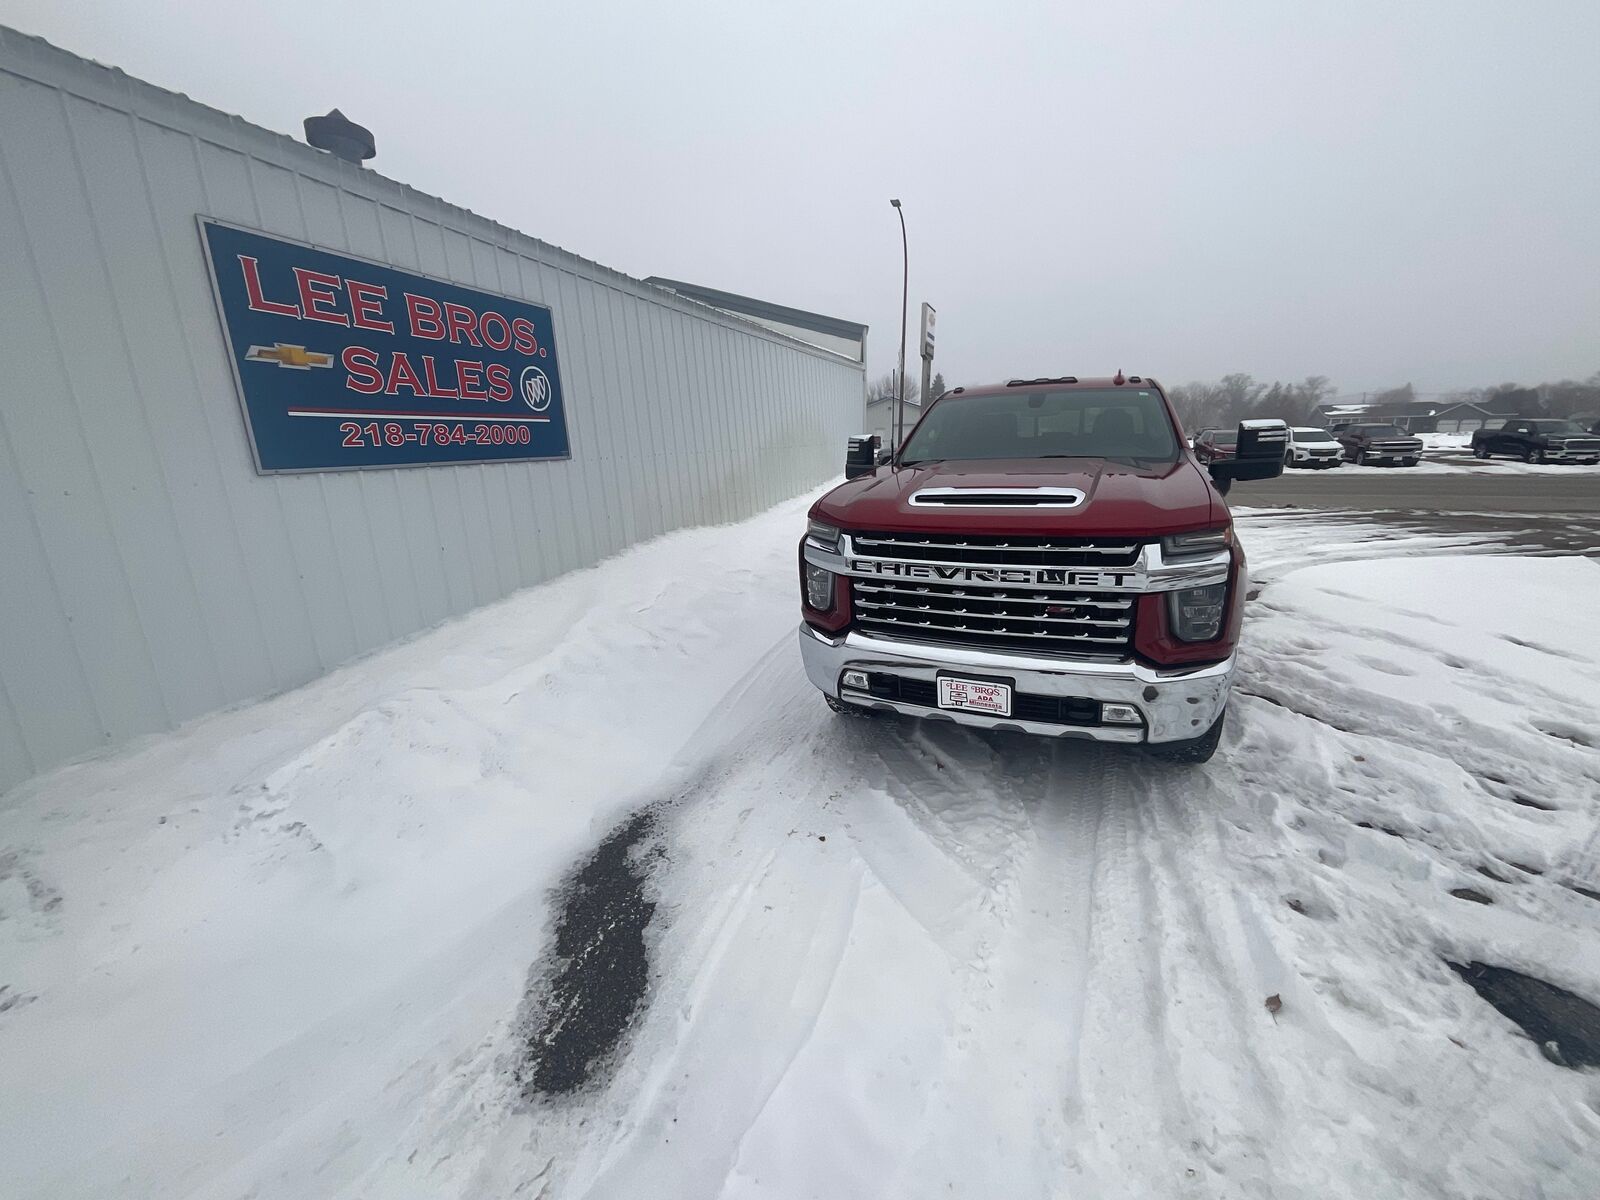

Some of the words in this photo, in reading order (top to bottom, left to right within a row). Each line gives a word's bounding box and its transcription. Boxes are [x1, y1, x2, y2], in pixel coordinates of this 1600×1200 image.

[237, 254, 395, 335] LEE
[404, 293, 547, 358] BROS.
[341, 345, 514, 402] SALES
[340, 422, 531, 447] 218-784-2000
[851, 559, 1136, 587] CHEVROLET
[946, 683, 968, 691] LEE
[969, 699, 1003, 710] Minnesota
